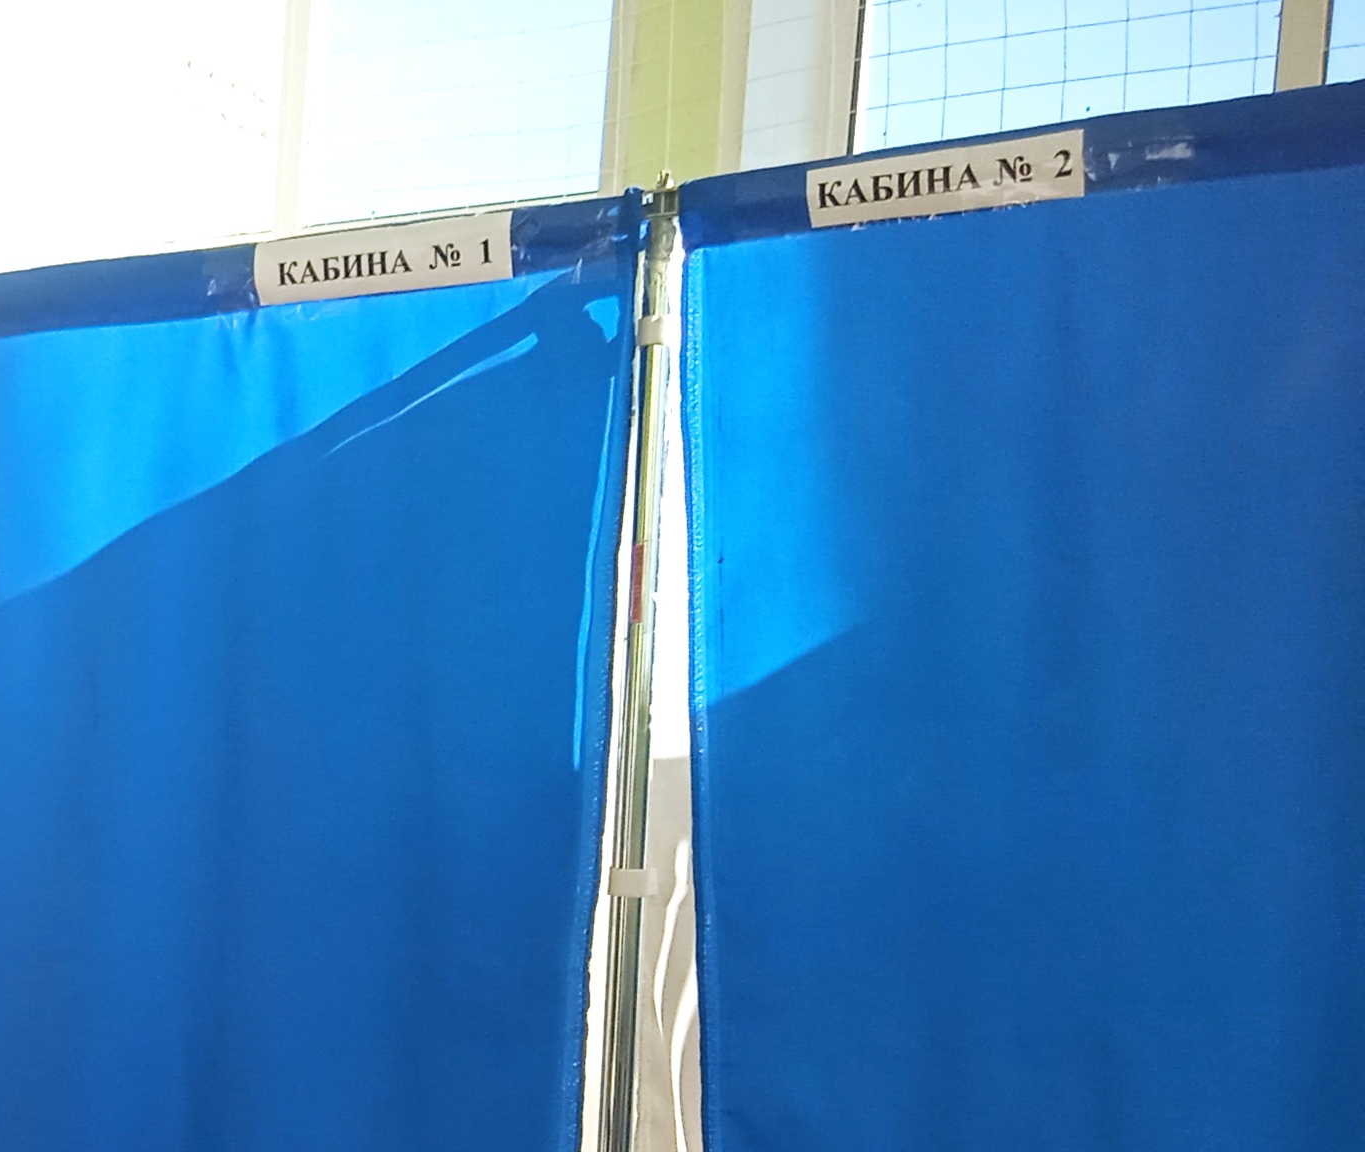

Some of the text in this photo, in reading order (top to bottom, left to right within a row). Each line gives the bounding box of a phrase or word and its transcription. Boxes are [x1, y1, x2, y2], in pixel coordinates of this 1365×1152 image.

[817, 149, 1073, 209] КАБИНА № 2
[278, 238, 493, 287] КАБИНА № 1
